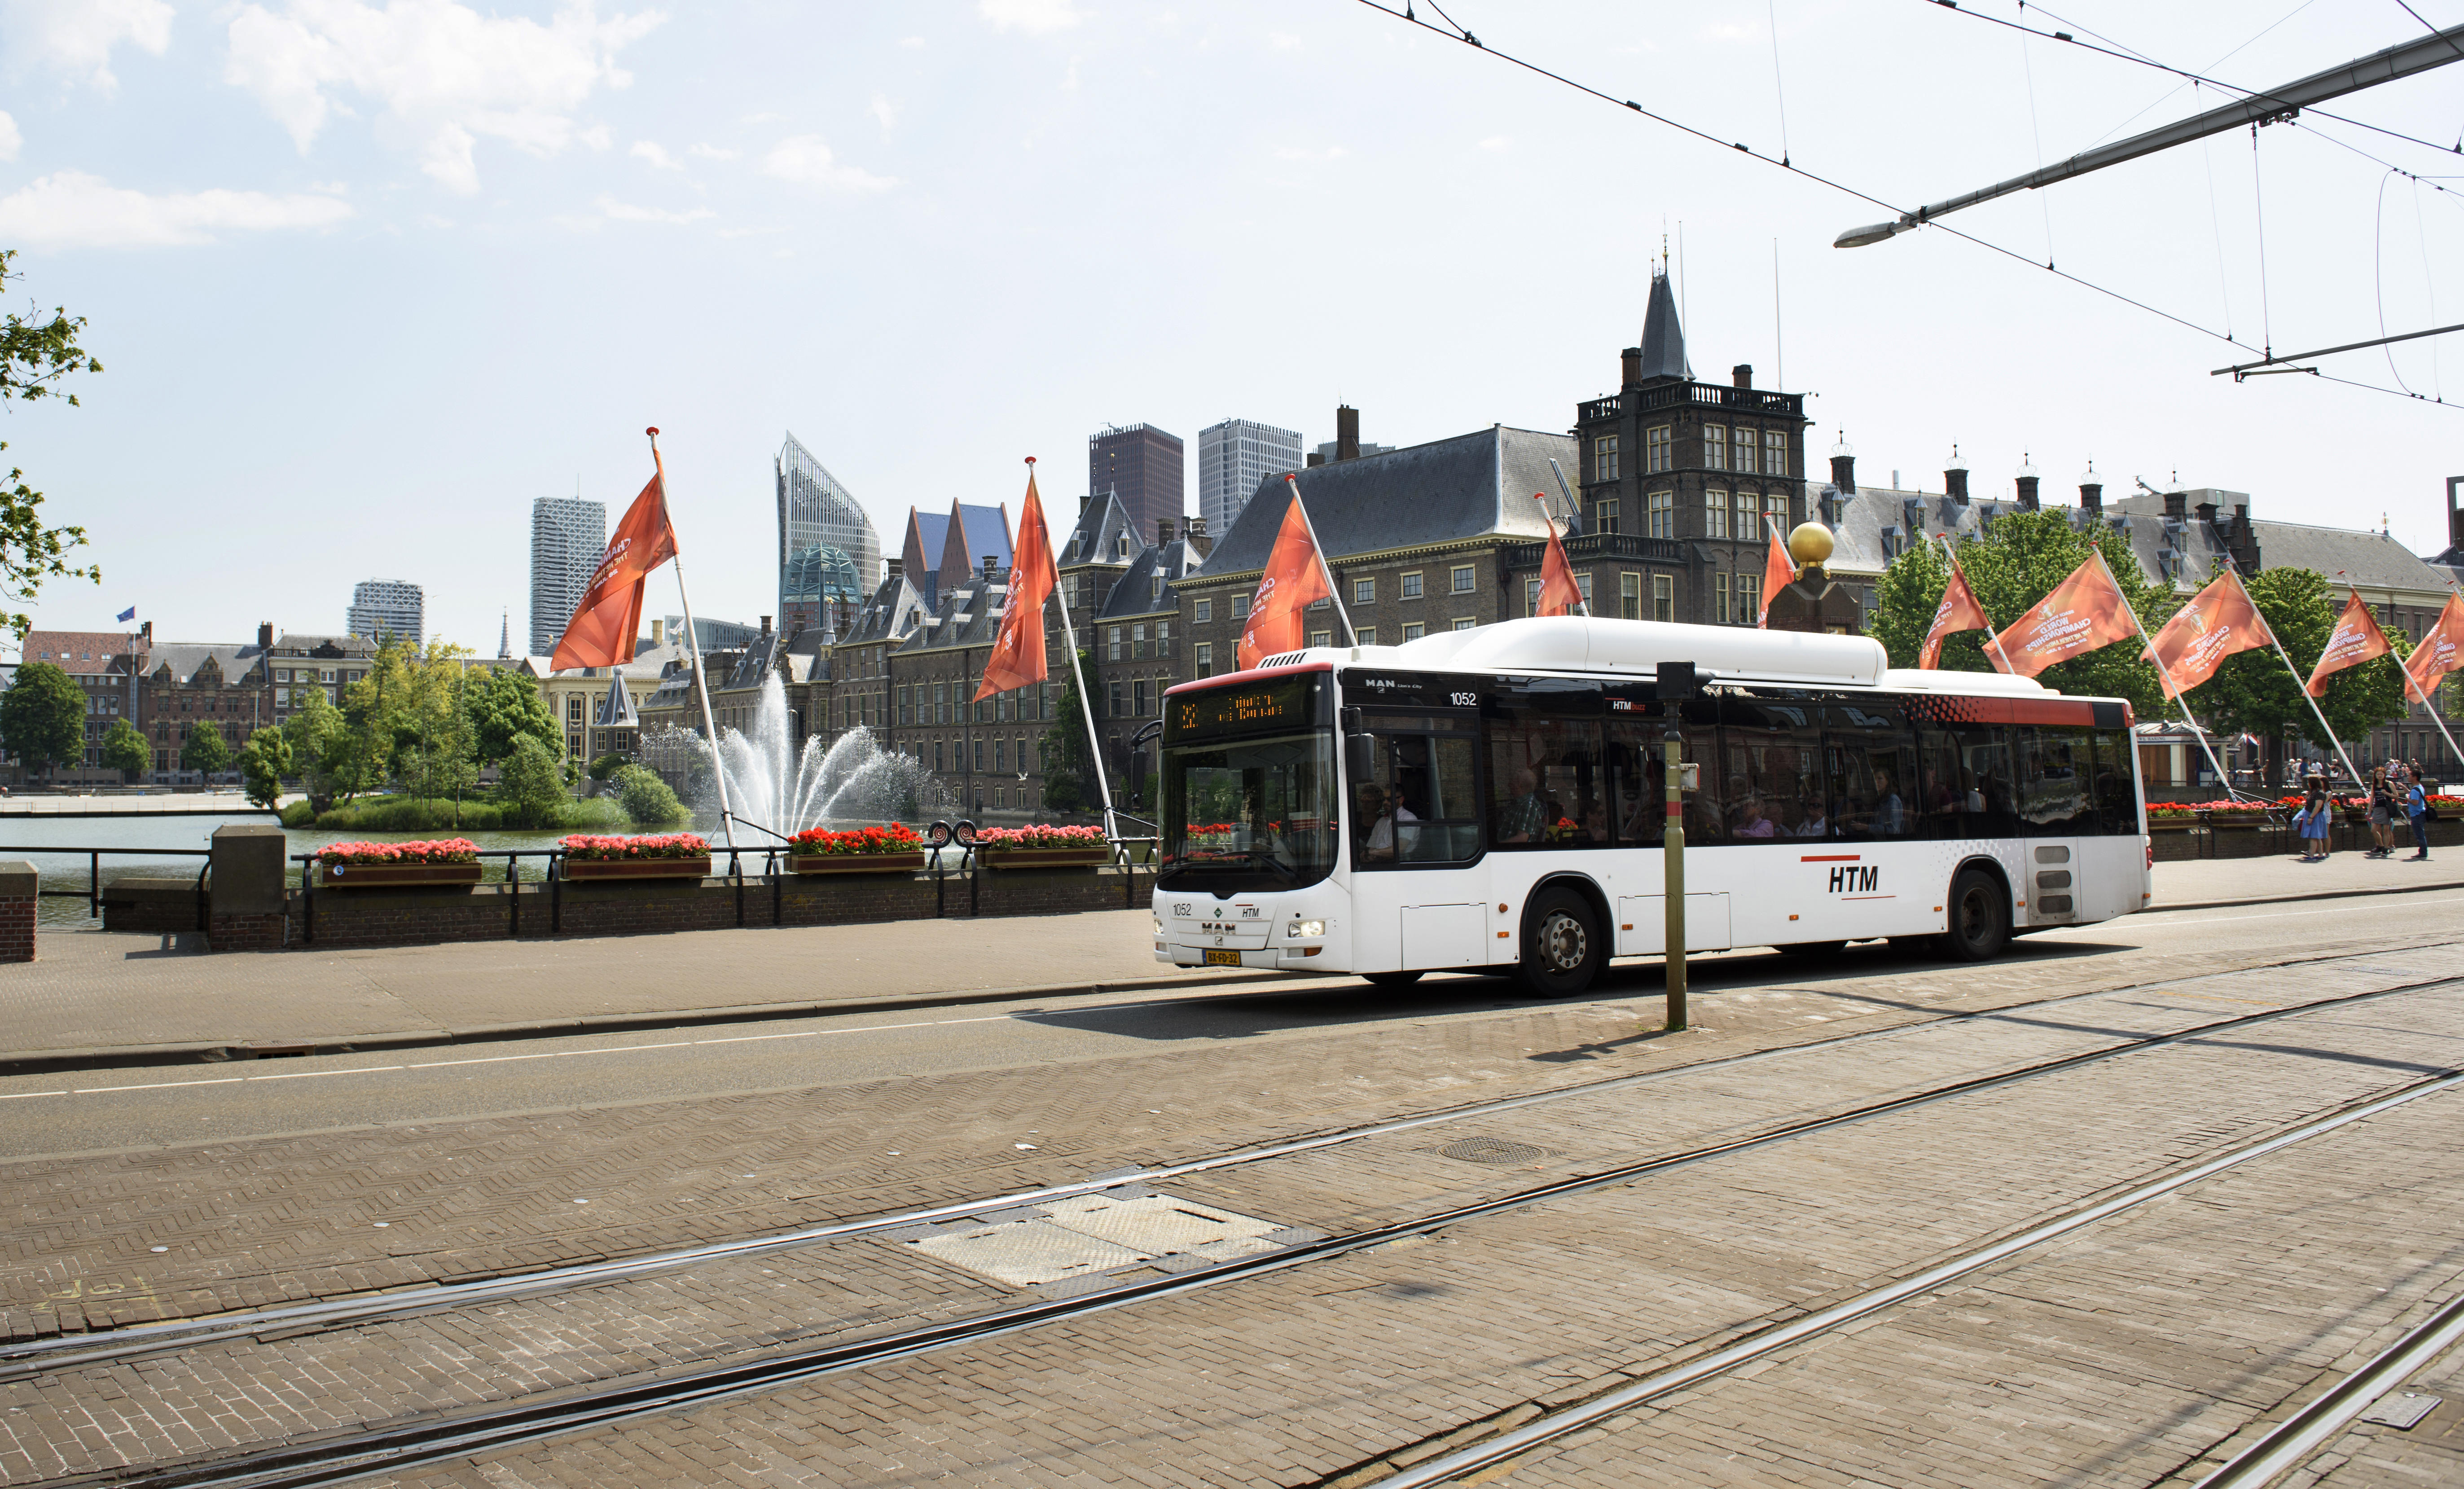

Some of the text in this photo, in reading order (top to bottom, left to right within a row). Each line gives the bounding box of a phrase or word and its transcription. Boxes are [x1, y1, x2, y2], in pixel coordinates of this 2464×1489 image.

[1366, 679, 1395, 687] MAN
[1450, 692, 1476, 706] 1052
[1829, 866, 1878, 893] HTM
[1173, 904, 1191, 916] 1052
[1242, 908, 1259, 918] HTM
[1202, 922, 1236, 934] MAN
[1208, 952, 1237, 963] BX-FD-32
